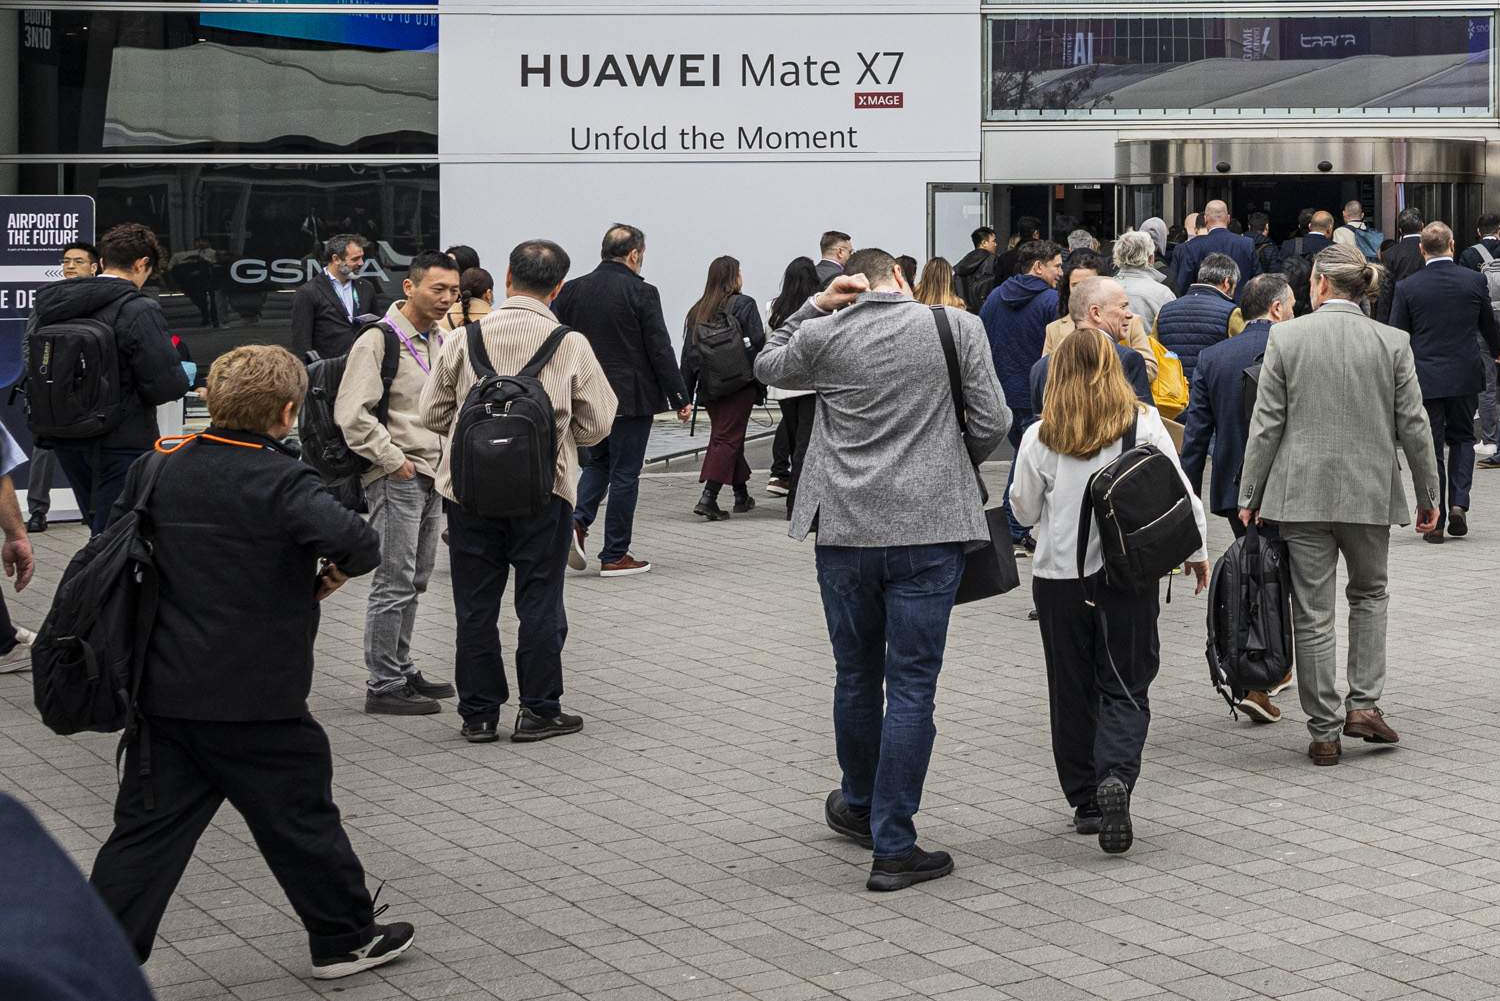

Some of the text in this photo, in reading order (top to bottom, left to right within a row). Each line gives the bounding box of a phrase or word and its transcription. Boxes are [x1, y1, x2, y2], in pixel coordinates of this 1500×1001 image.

[24, 26, 51, 49] 3N10
[520, 51, 904, 88] HUAWEI Mate X7
[858, 95, 900, 106] XMAGE
[571, 126, 859, 151] Unfold the Moment
[7, 213, 79, 229] AIRPORT OF
[7, 229, 31, 245] THE
